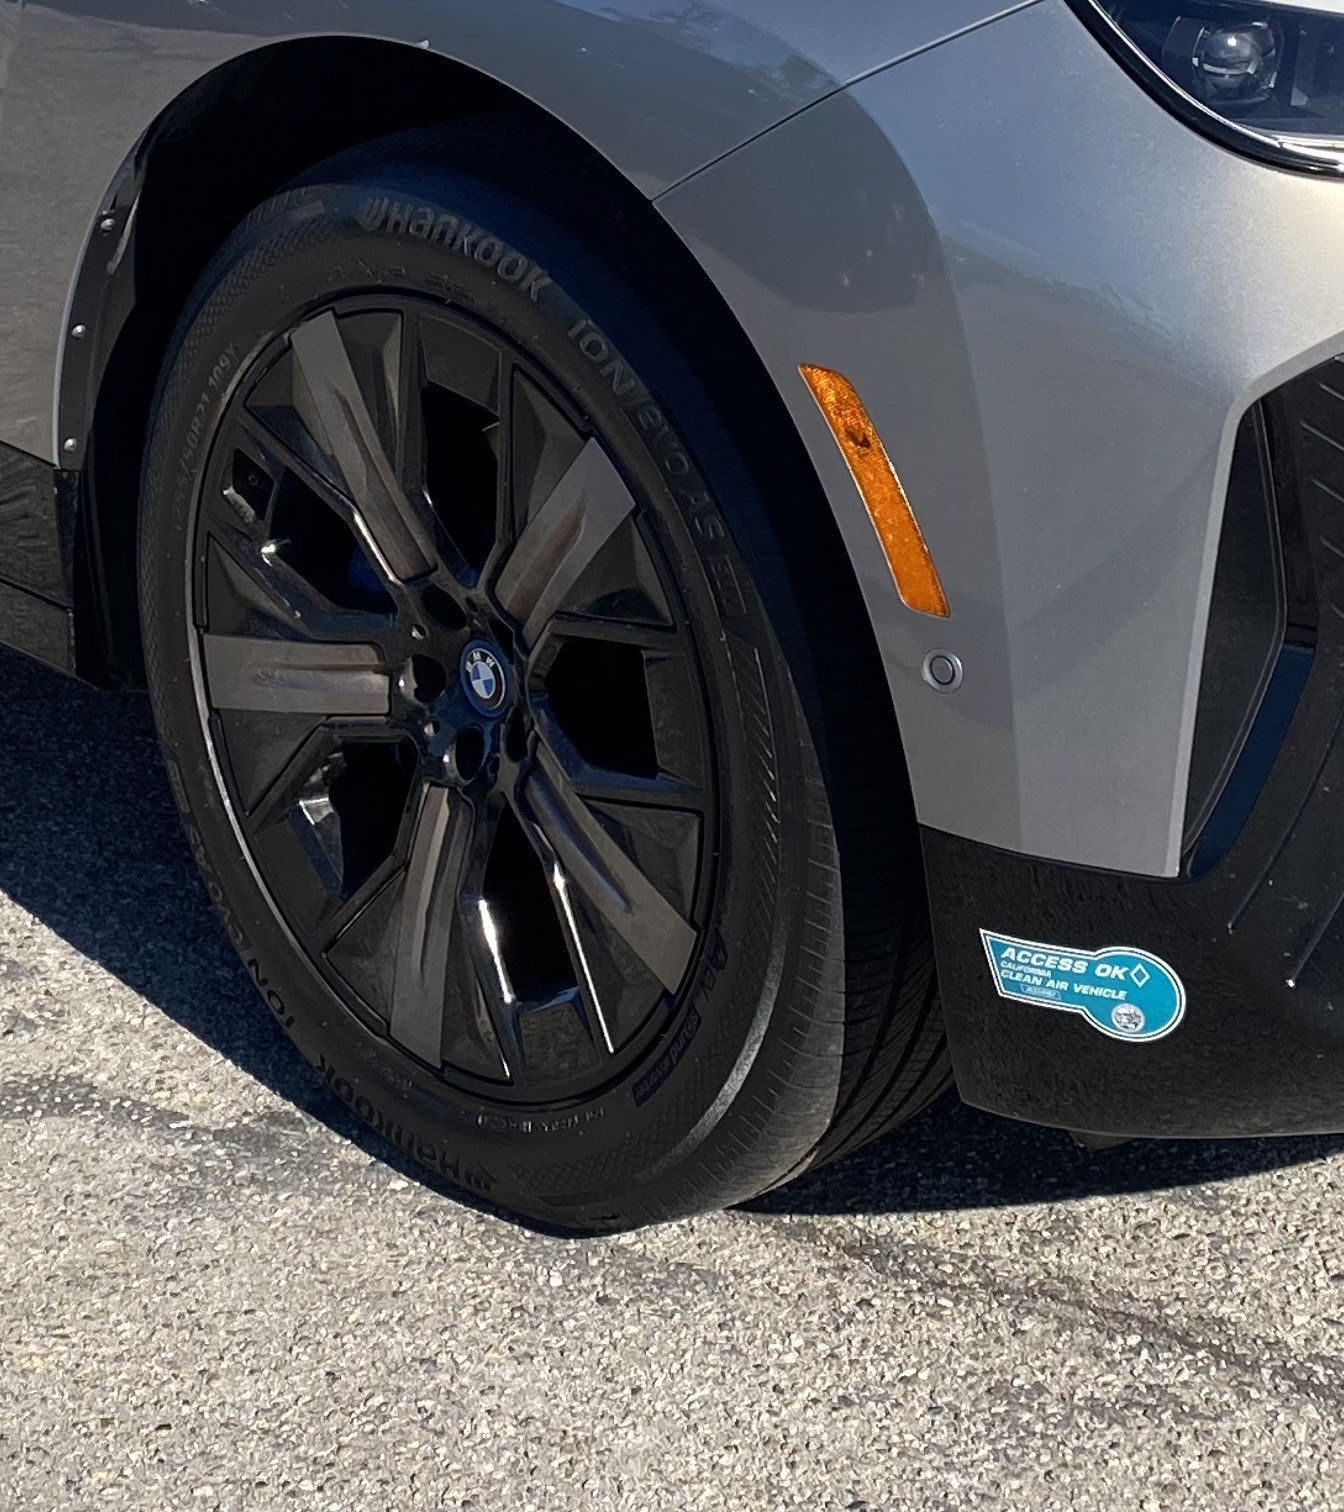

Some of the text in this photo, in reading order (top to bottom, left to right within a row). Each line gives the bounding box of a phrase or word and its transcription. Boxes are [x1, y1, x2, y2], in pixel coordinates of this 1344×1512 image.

[999, 961, 1052, 978] CALIFORNIA
[1001, 947, 1130, 981] ACCESS OK
[1000, 969, 1044, 987] CLEAN
[1045, 979, 1069, 992] AIR
[1072, 983, 1128, 1001] VEHICLE
